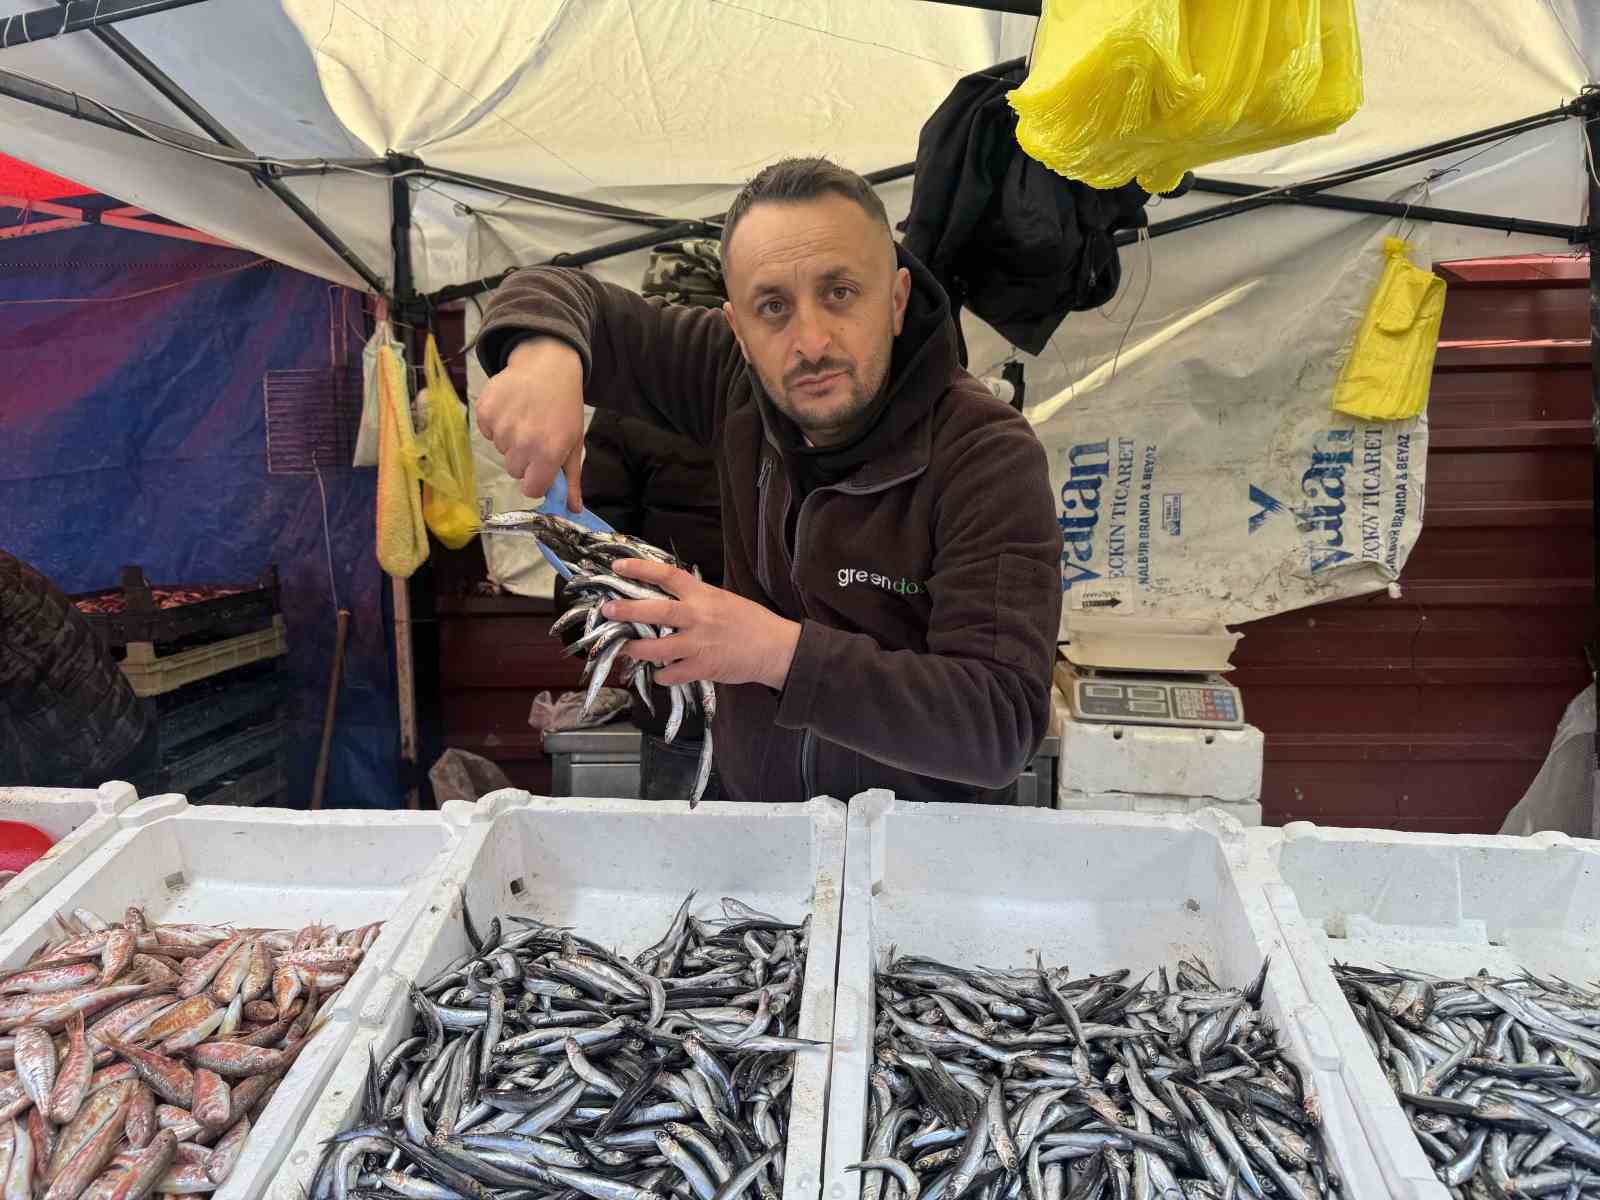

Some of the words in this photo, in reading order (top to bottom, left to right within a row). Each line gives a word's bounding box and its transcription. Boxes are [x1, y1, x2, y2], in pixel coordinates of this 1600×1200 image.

[1142, 445, 1157, 481] BEYAZ
[1359, 429, 1384, 510] TİCARET
[1395, 433, 1411, 471] BEYAZ
[1110, 437, 1135, 521] TİCARET
[1141, 483, 1152, 491] &
[1395, 474, 1409, 483] &
[1138, 494, 1151, 538] BRANDA
[1391, 484, 1409, 528] BRANDA
[1106, 524, 1128, 580] EÇKİN
[1385, 529, 1401, 570] ALBUR
